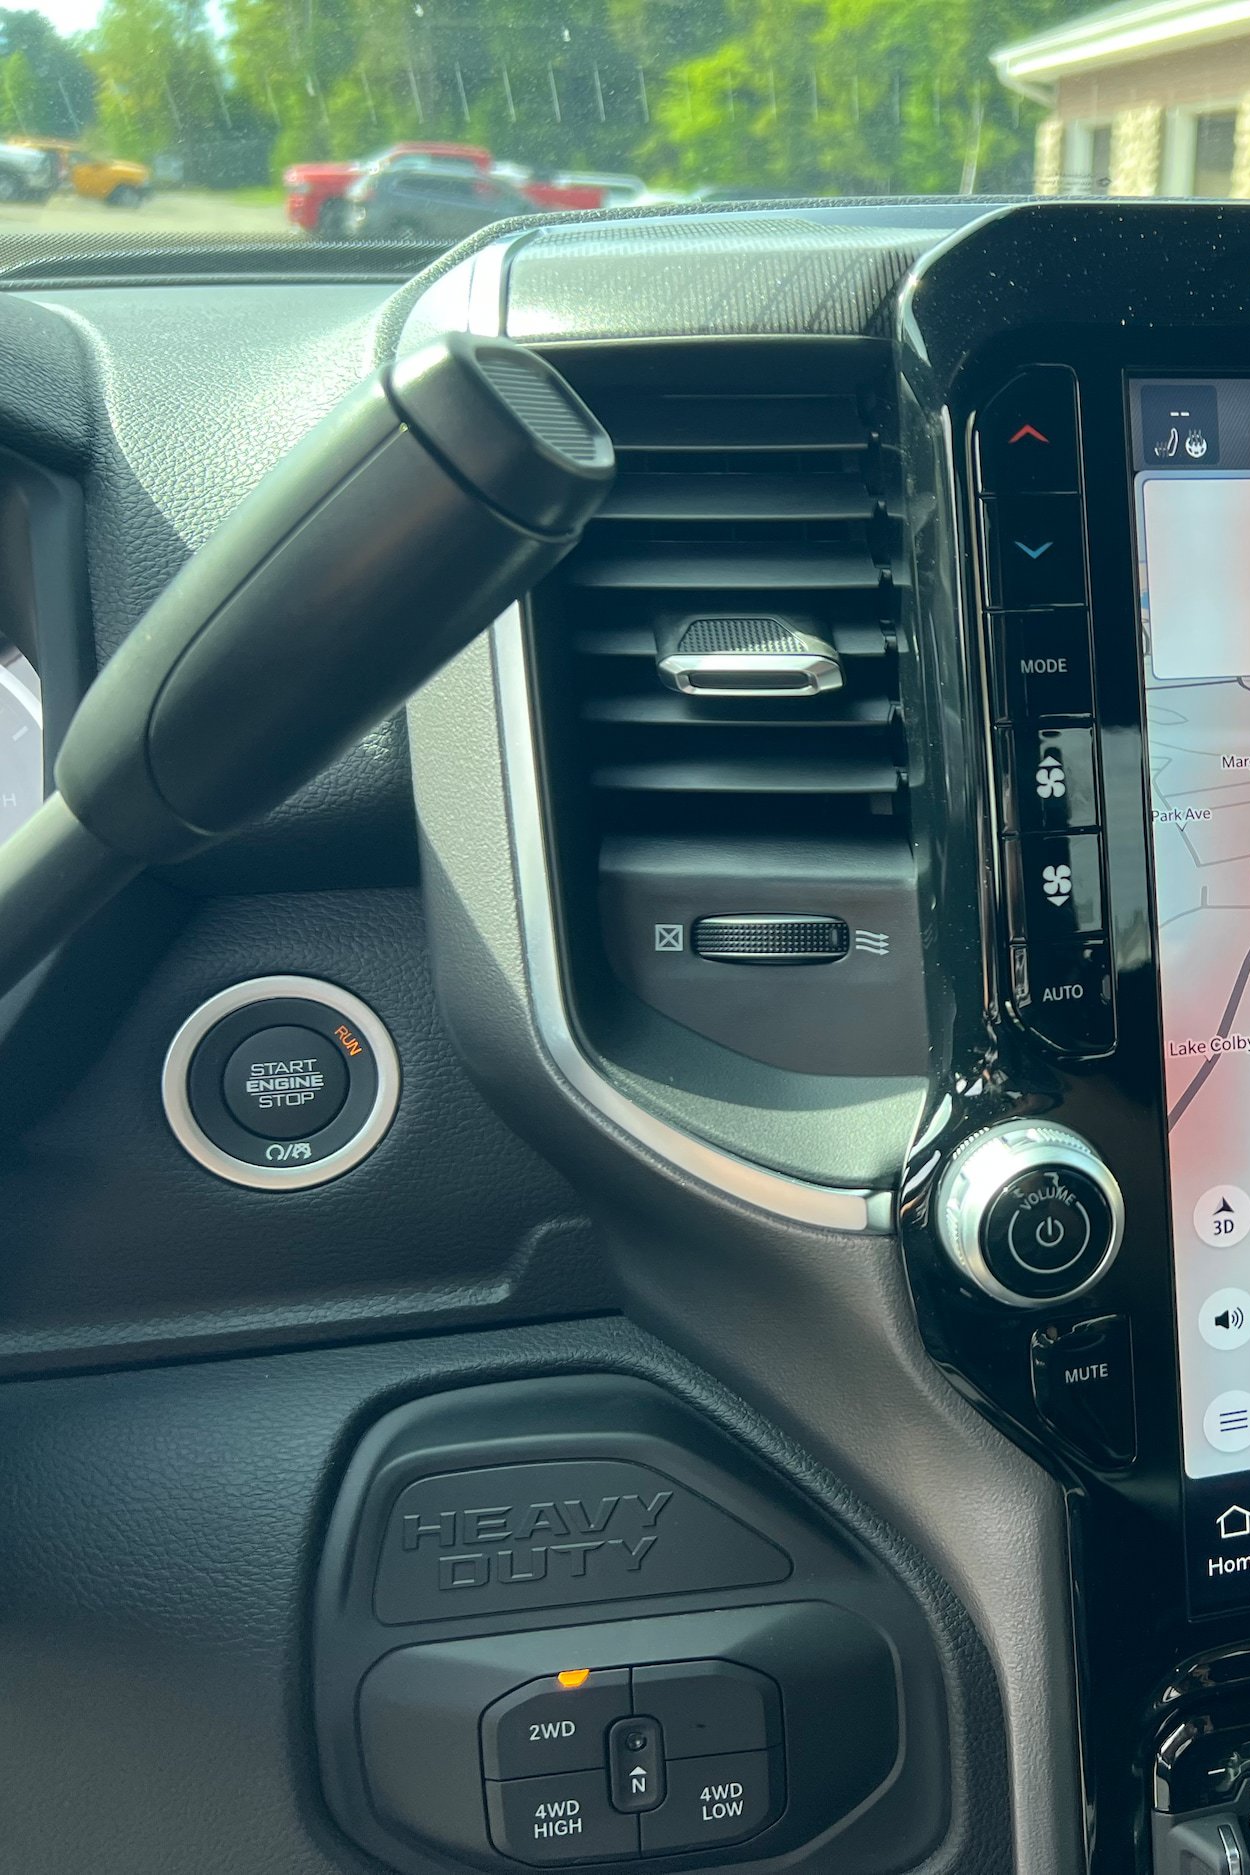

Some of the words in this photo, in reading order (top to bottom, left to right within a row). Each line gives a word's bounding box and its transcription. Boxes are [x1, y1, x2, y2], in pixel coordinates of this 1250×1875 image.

[1020, 658, 1067, 673] MODE
[1151, 809, 1182, 822] Park
[1185, 807, 1211, 820] Ave
[1042, 984, 1083, 1002] AUTO
[334, 1025, 362, 1056] RUN
[1169, 1042, 1207, 1056] Lake
[250, 1059, 317, 1076] START
[246, 1075, 325, 1093] ENGINE
[259, 1092, 315, 1108] STOP
[1019, 1184, 1077, 1212] VOLUME
[1212, 1219, 1235, 1235] 3D
[1064, 1363, 1109, 1384] MUTE
[403, 1490, 674, 1551] HEAVY
[438, 1535, 658, 1592] DUTY
[528, 1720, 577, 1743] 2WD
[631, 1777, 647, 1794] N
[699, 1782, 745, 1805] 4WD
[534, 1800, 580, 1822] 4WD
[702, 1800, 745, 1822] LOW
[533, 1818, 584, 1840] HIGH
